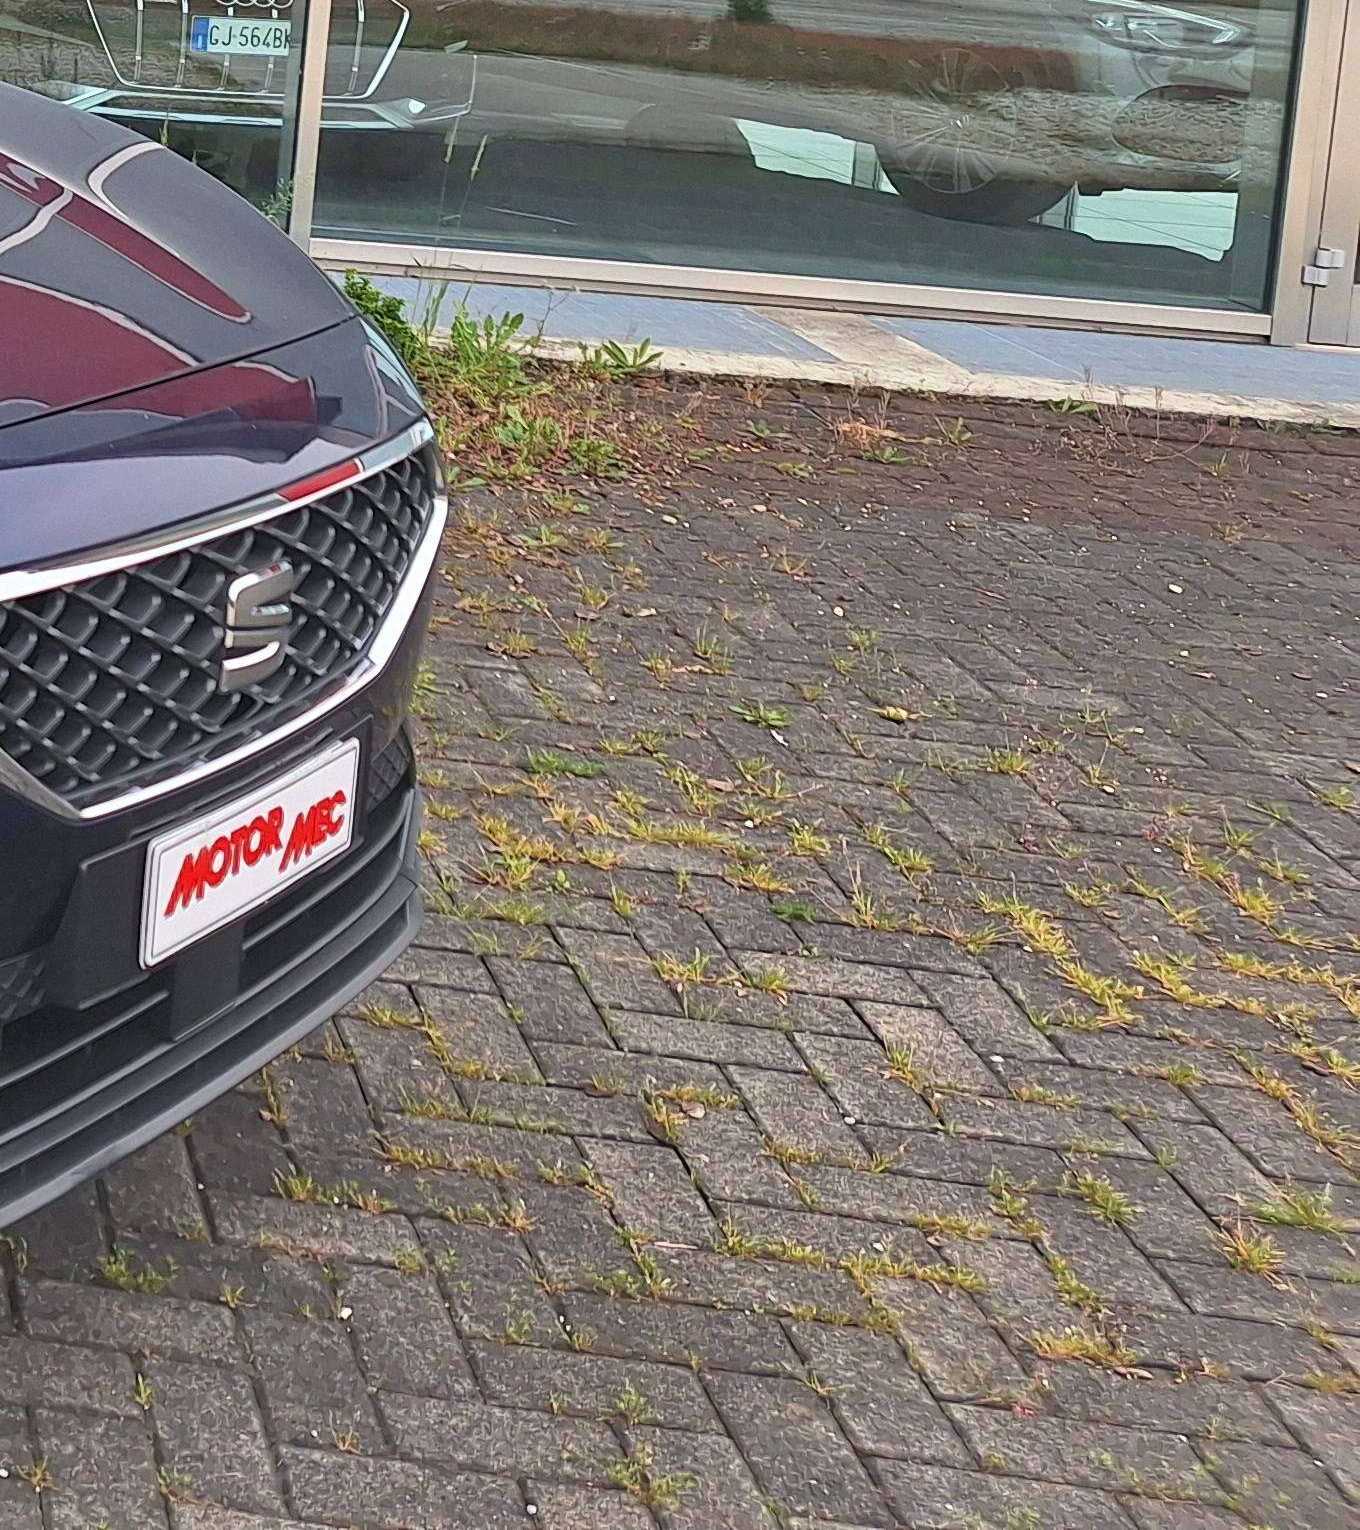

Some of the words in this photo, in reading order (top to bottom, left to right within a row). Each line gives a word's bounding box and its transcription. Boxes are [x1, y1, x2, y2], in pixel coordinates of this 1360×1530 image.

[209, 25, 233, 47] GJ
[164, 806, 285, 917] MOTOR
[279, 789, 348, 871] MEC
